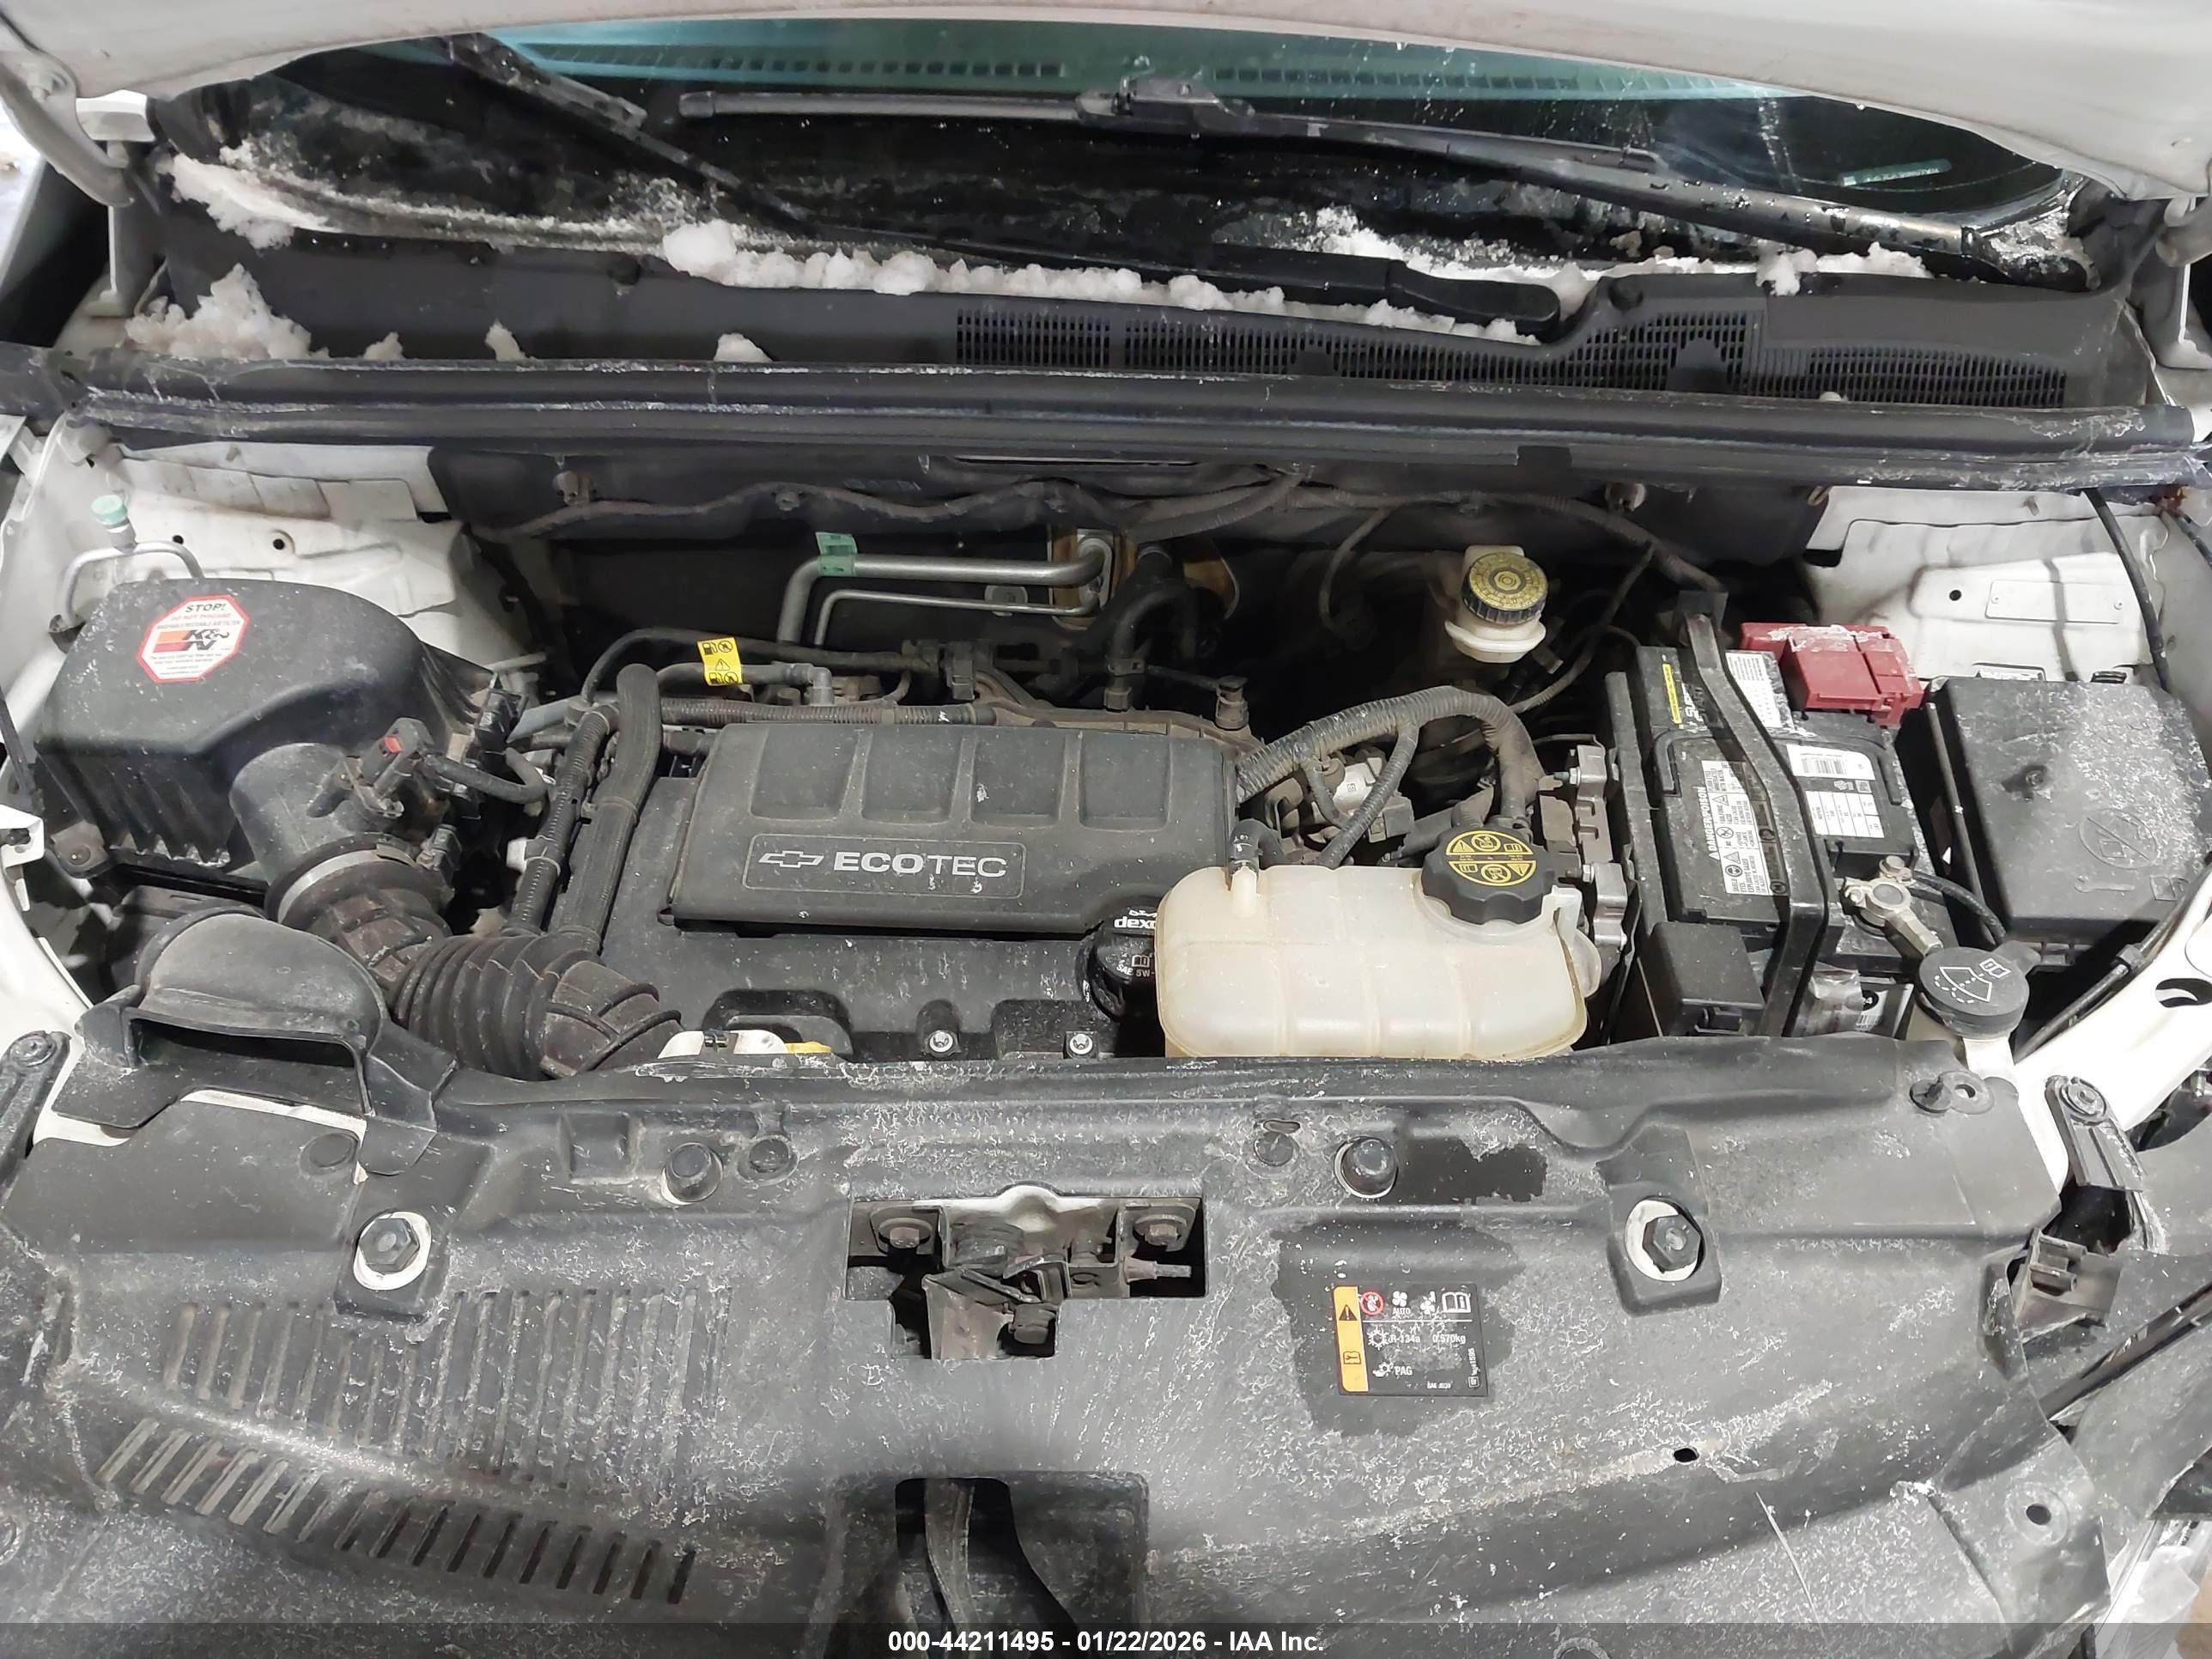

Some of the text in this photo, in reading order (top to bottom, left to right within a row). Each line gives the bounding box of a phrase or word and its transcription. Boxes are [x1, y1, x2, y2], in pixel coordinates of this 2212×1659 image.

[185, 603, 227, 612] STOP!
[1697, 787, 1717, 851] DANGER/POISON
[834, 852, 1006, 877] ECOTEC
[1116, 963, 1155, 977] SAE 5W-
[1395, 1366, 1413, 1376] PAG
